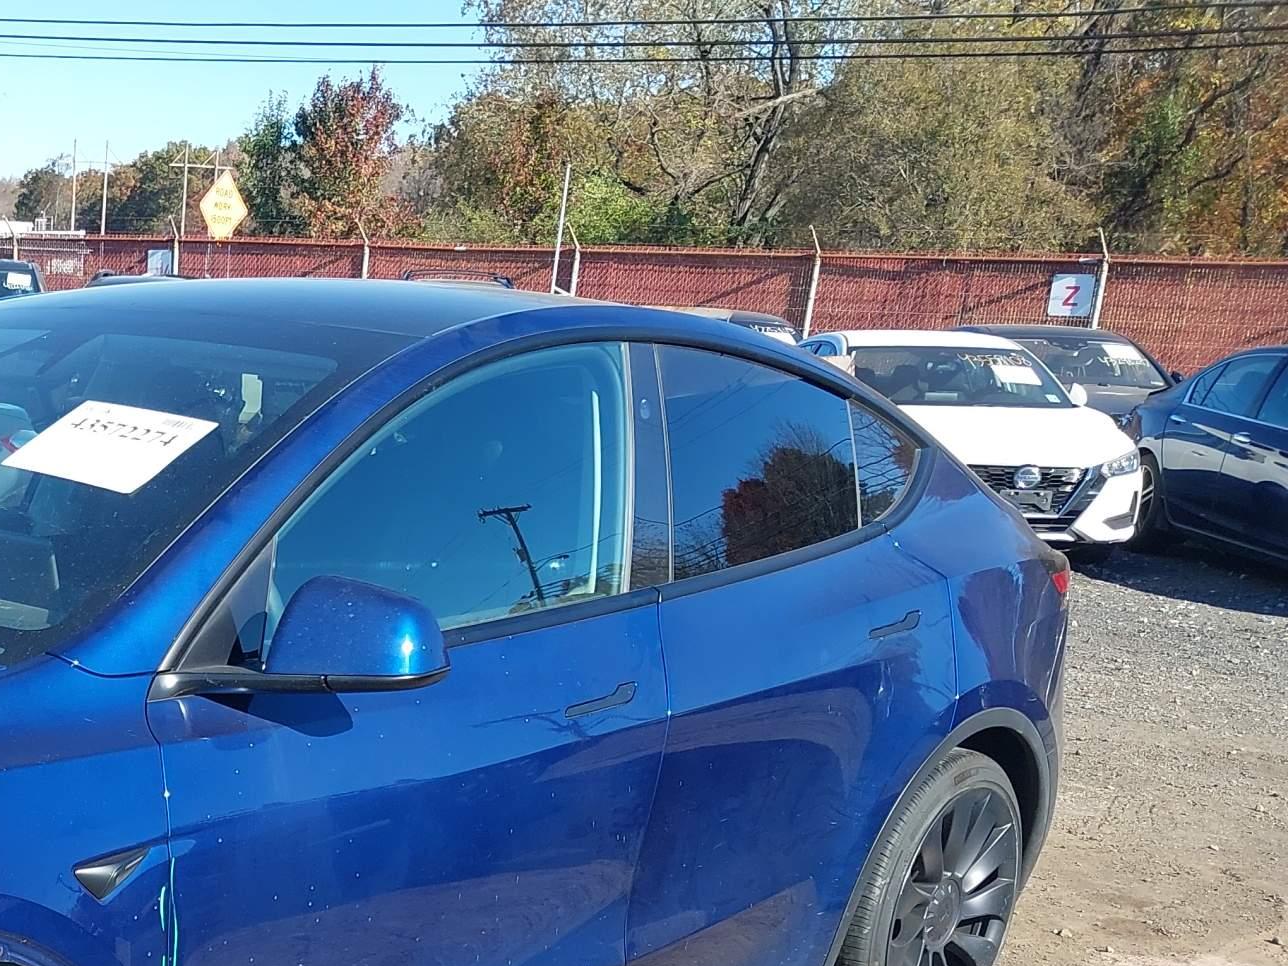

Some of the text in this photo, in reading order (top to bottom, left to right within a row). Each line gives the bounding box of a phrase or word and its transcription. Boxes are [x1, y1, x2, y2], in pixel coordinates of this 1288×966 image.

[216, 187, 233, 198] ROAD
[214, 202, 231, 210] WORK
[1062, 285, 1081, 307] Z
[71, 418, 179, 447] 43572274
